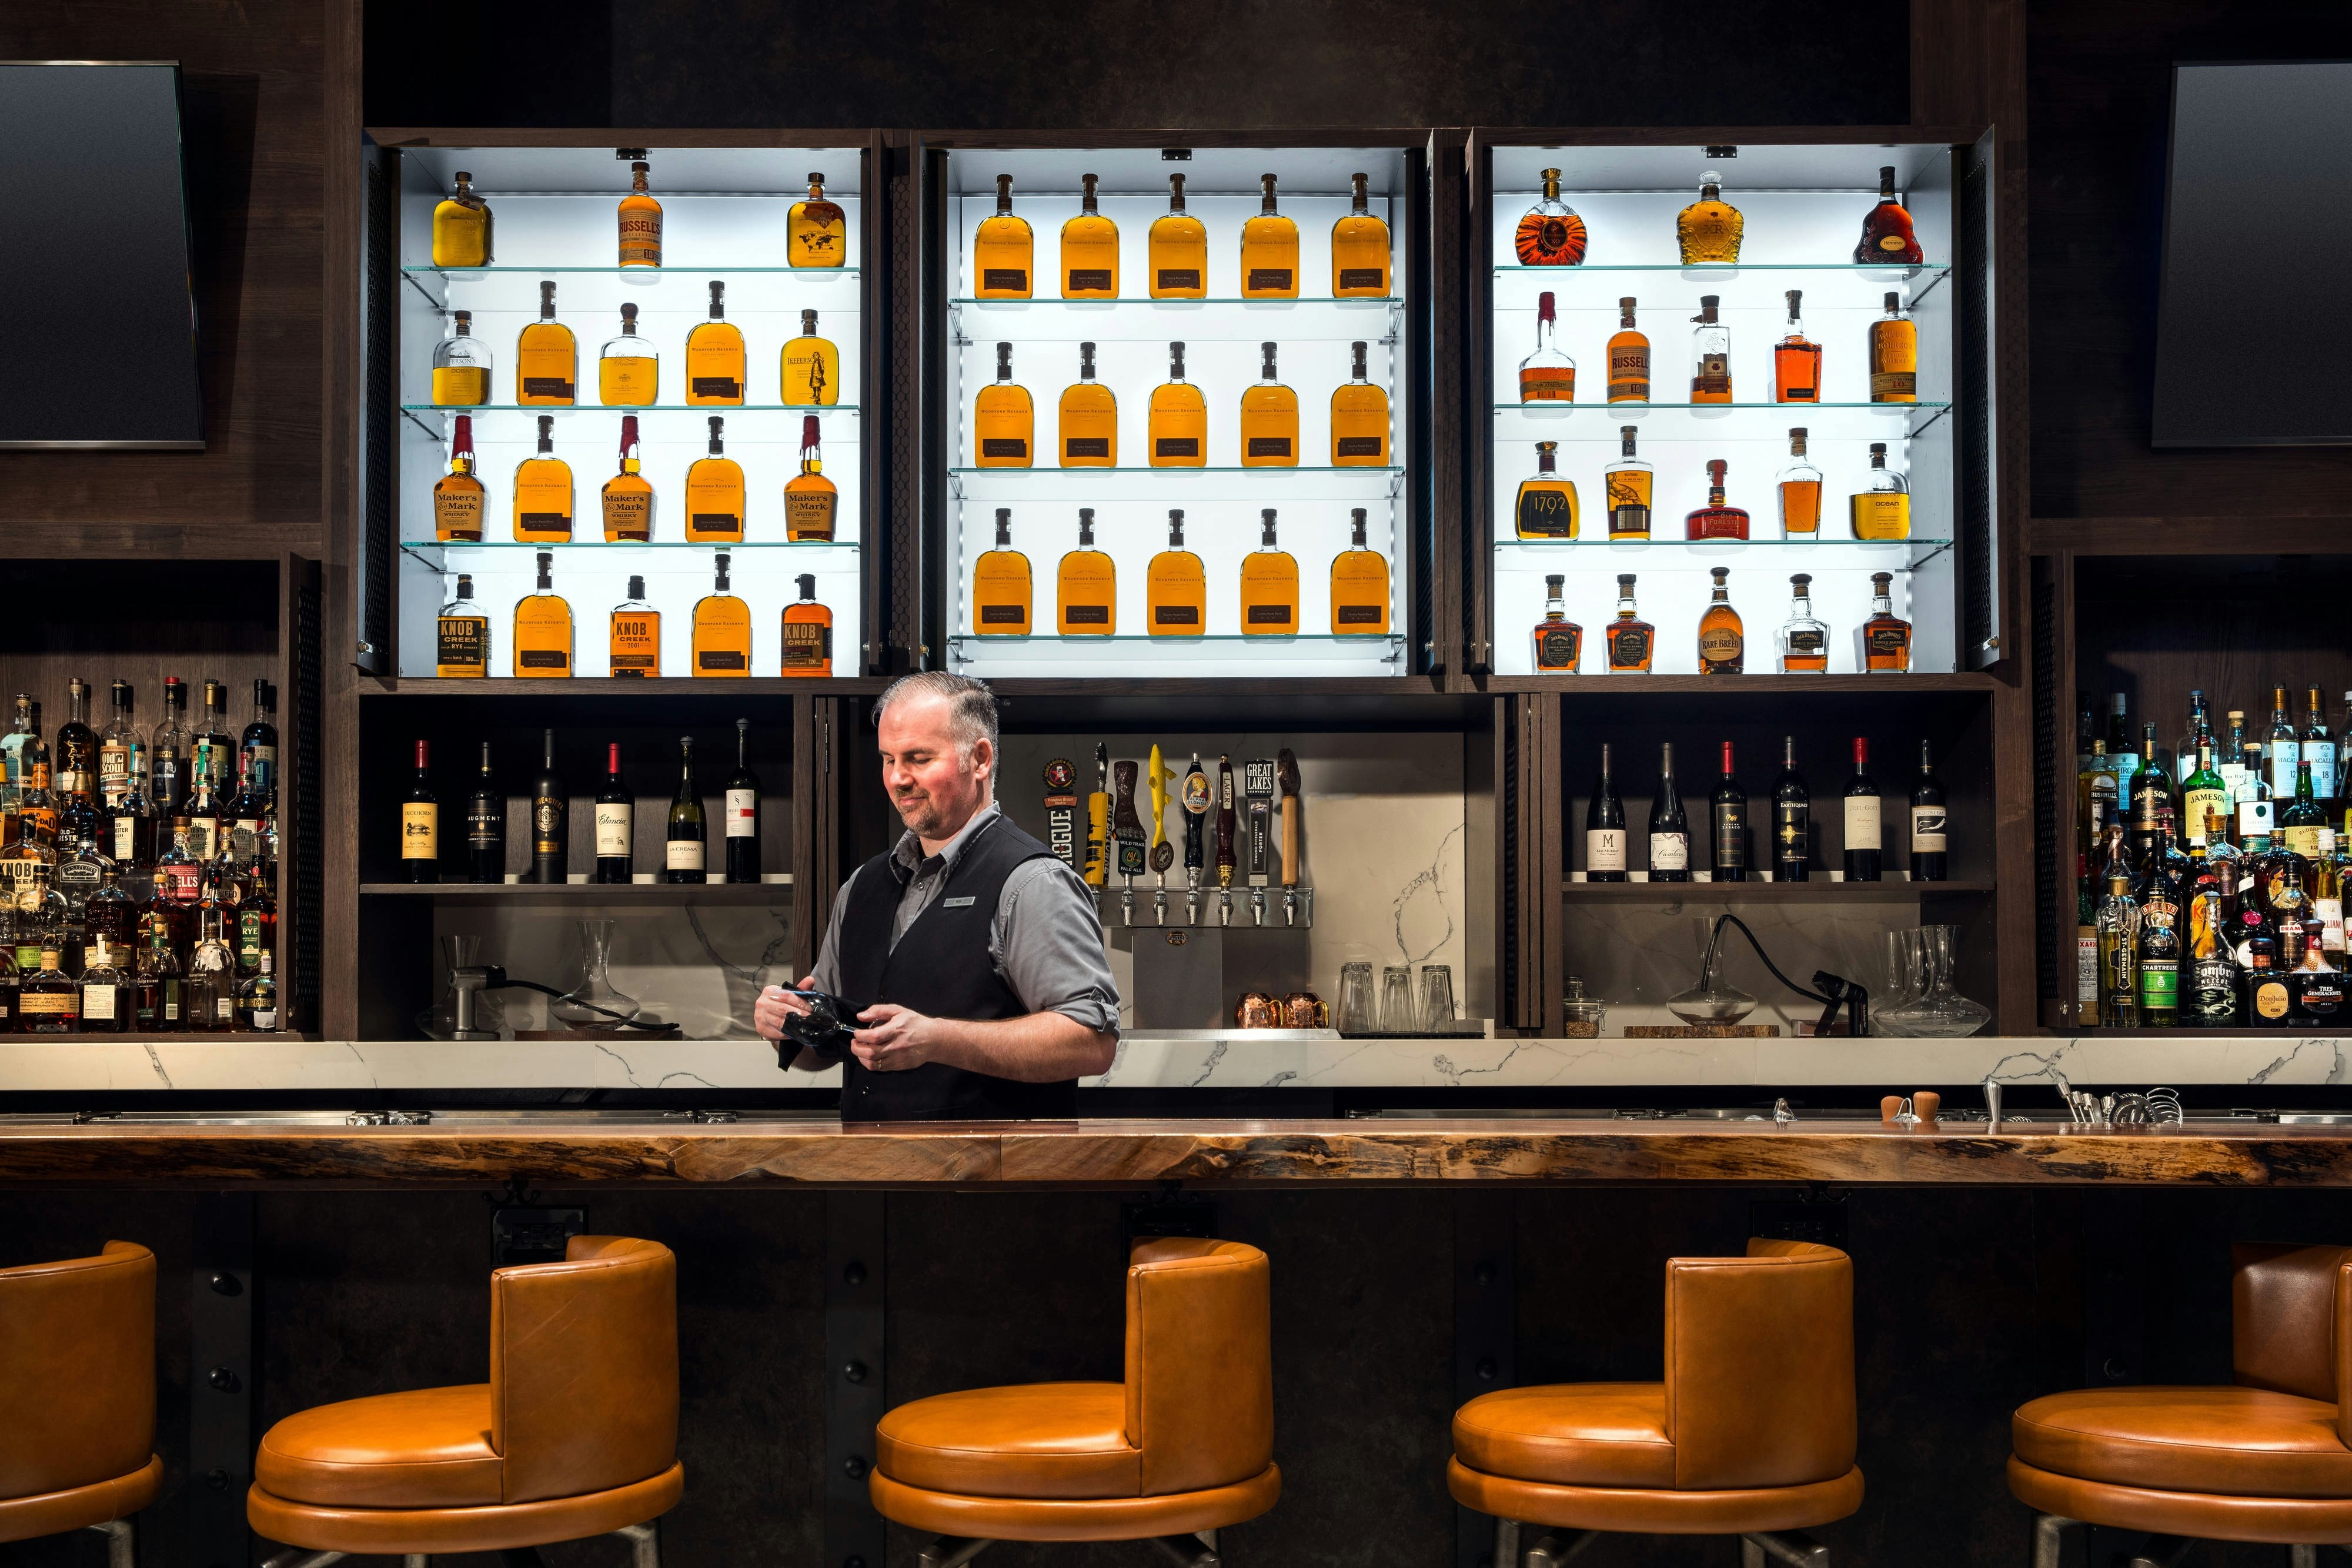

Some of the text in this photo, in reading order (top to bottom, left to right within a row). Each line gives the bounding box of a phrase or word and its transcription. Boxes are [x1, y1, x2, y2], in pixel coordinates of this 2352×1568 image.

[620, 220, 660, 235] RUSSELL'S
[1703, 224, 1725, 234] XR
[1632, 385, 1640, 393] 10
[1535, 498, 1565, 515] 1792
[442, 621, 473, 636] KNOB
[617, 622, 647, 636] KNOB
[784, 624, 816, 638] KNOB
[1796, 632, 1819, 641] JACK DANIEL'S
[1887, 631, 1901, 640] DANIEL'S
[1702, 639, 1739, 650] RARE BREED
[102, 753, 115, 763] Old
[102, 763, 124, 774] Scout
[1247, 764, 1272, 777] GREAT
[2323, 771, 2329, 779] 18
[1247, 777, 1272, 790] LAKES
[2134, 790, 2167, 801] JAMESON
[2190, 794, 2225, 804] JAMESON
[599, 814, 627, 825] Estancia
[2298, 827, 2320, 835] REDBRE
[1658, 848, 1685, 859] Cambria
[0, 862, 31, 878] KNOB
[64, 864, 97, 872] GENTLEMAN
[169, 876, 198, 888] SELL'S
[141, 913, 150, 922] JIM
[2192, 964, 2234, 982] Sombra
